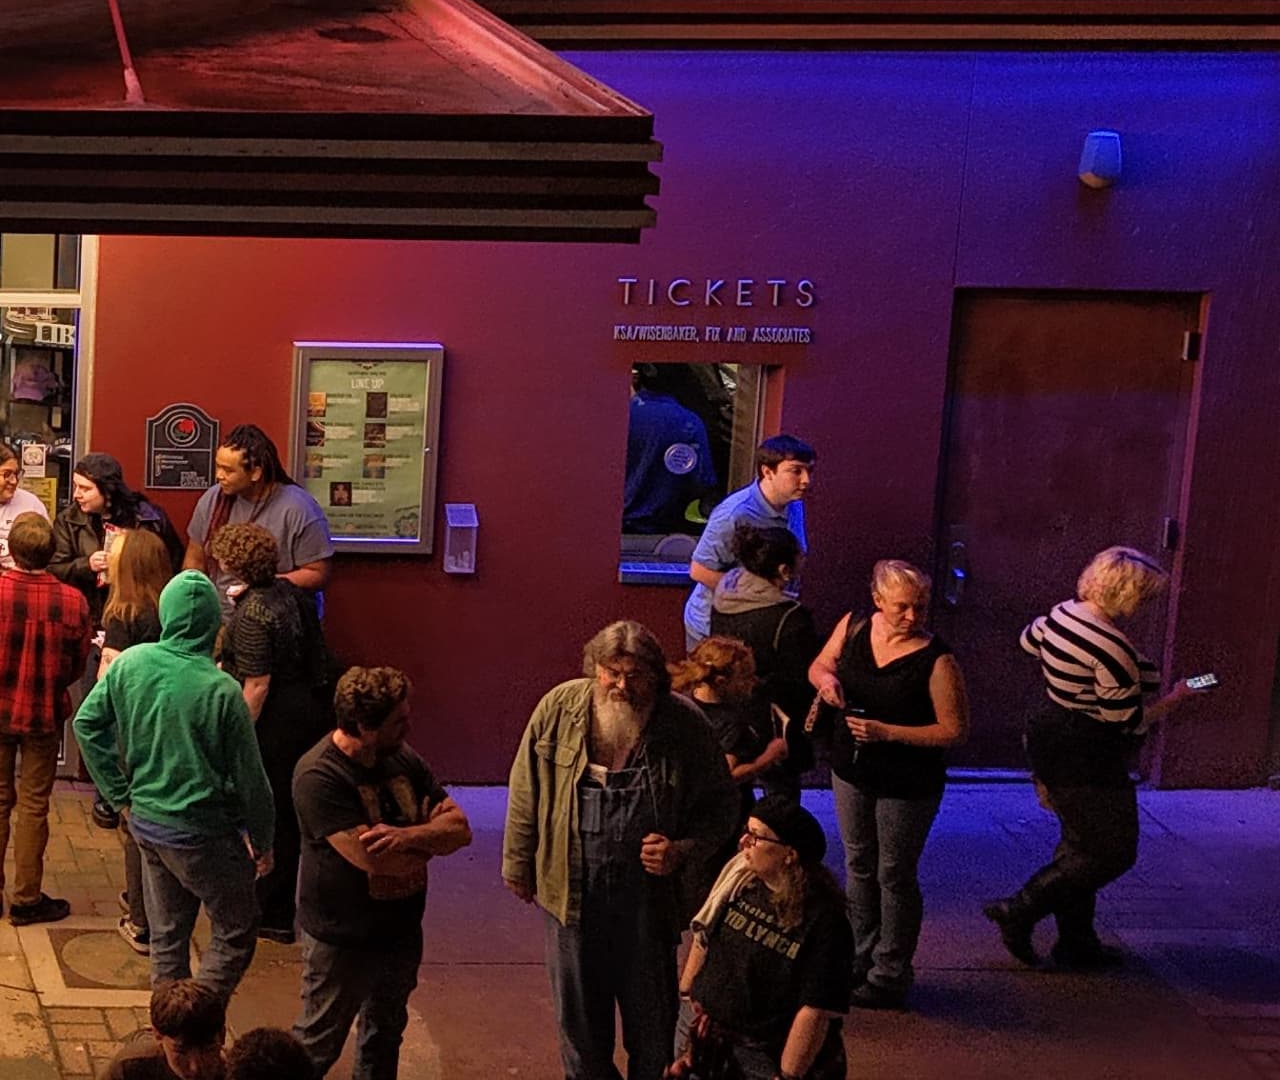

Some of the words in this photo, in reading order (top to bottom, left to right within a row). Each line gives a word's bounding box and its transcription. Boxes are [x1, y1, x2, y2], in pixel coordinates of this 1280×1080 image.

[617, 277, 817, 308] TICKETS
[727, 327, 748, 343] AND
[752, 327, 812, 344] ASSOCIATES
[744, 920, 801, 960] LYNCH
